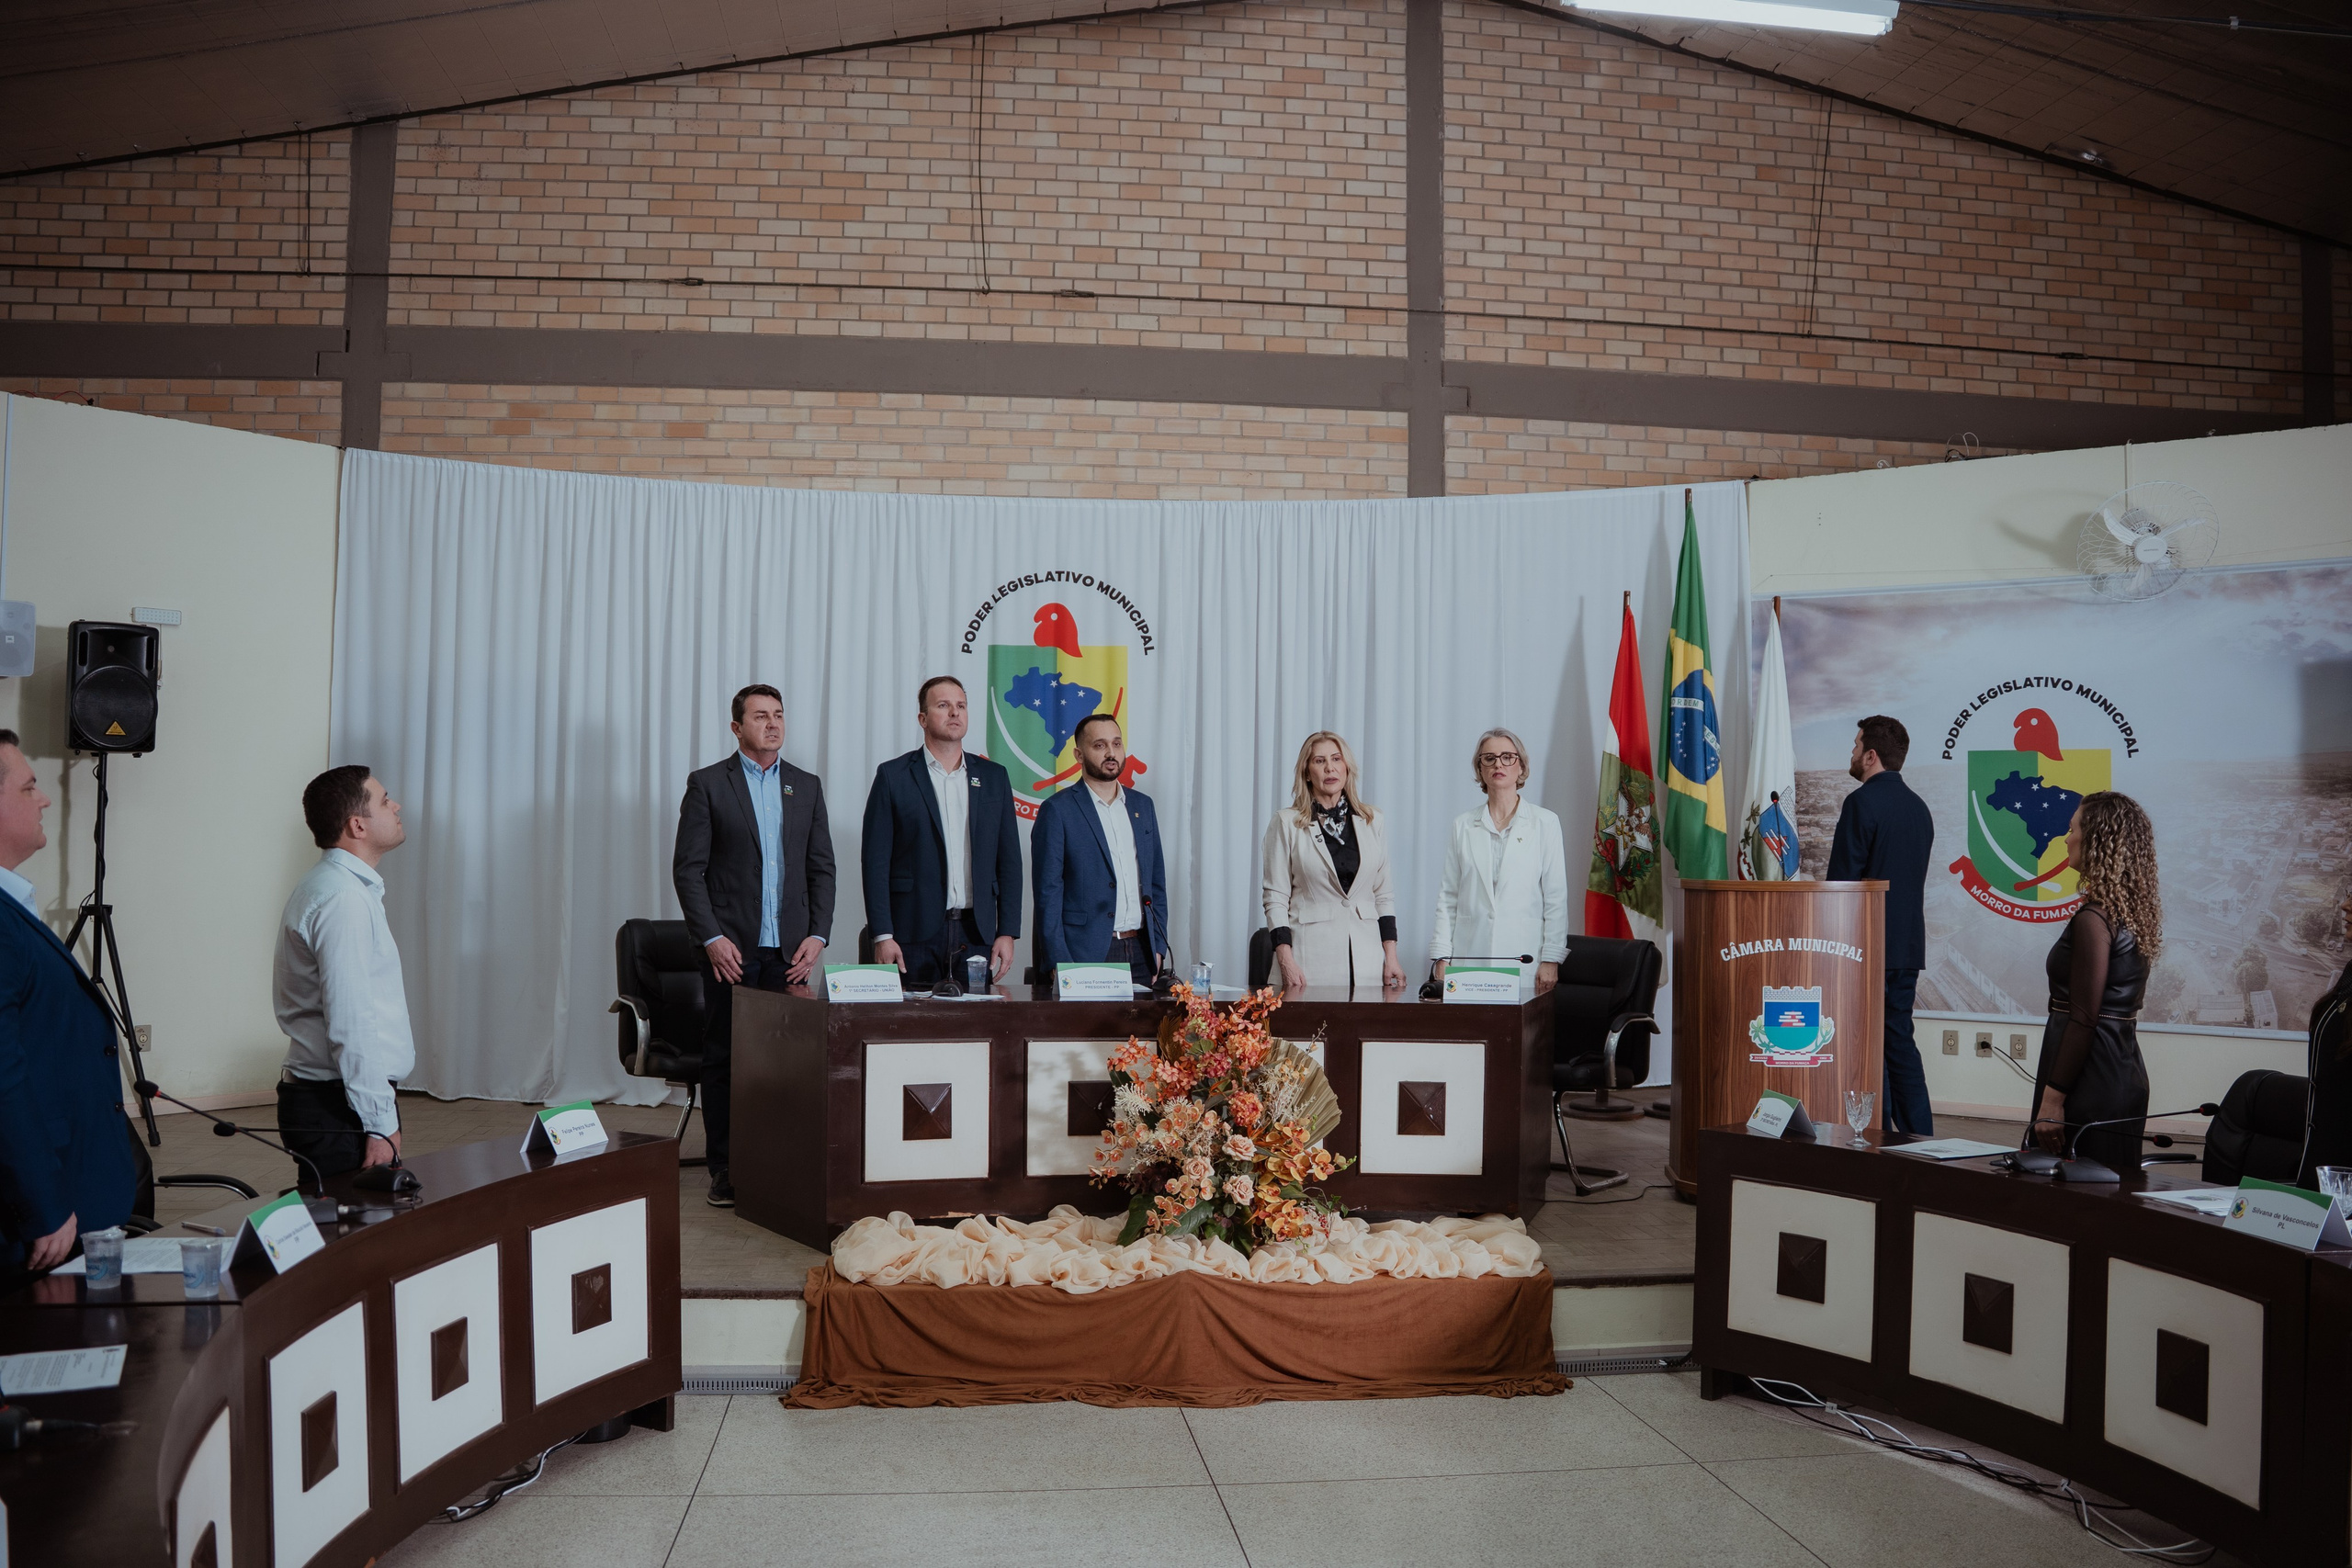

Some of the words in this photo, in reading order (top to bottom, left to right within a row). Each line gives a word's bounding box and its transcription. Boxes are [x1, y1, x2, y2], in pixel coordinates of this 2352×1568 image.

[961, 601, 993, 655] PODER
[992, 570, 1094, 604] LEGISLATIVO
[1096, 581, 1155, 656] MUNICIPAL
[1672, 698, 1699, 707] ORDEM
[1942, 709, 1973, 761] PODER
[1970, 676, 2074, 712] LEGISLATIVO
[2075, 684, 2139, 759] MUNICIPAL
[1971, 885, 2012, 914] MORRO
[2013, 908, 2030, 919] DA
[1720, 938, 1784, 962] CÂMARA
[1788, 937, 1863, 963] MUNICIPAL
[2252, 1206, 2273, 1219] Silvana
[2282, 1213, 2319, 1229] Vasconcelos
